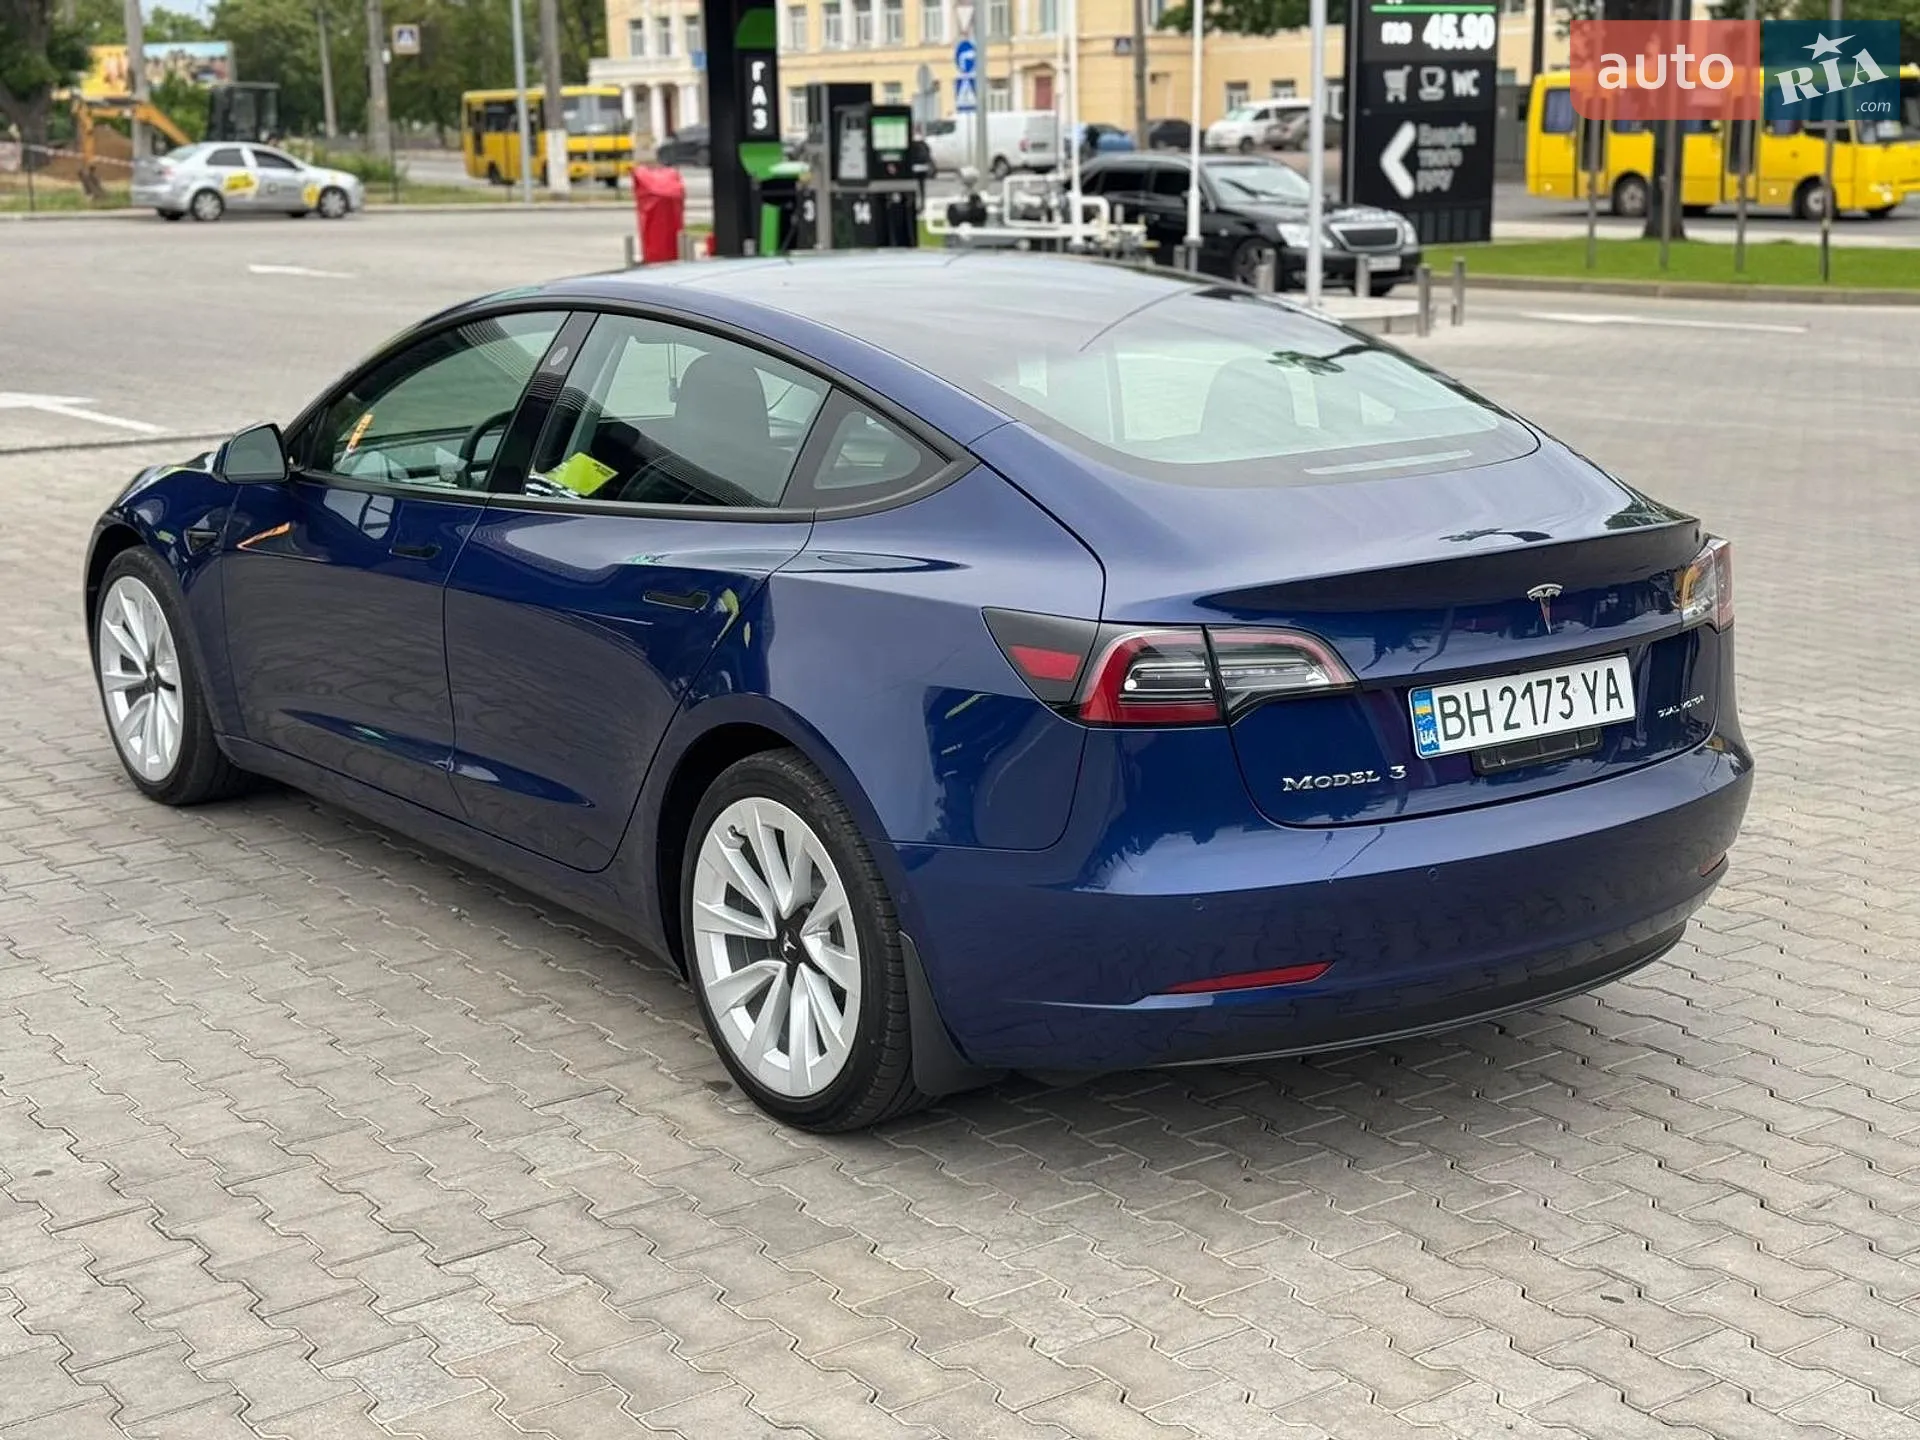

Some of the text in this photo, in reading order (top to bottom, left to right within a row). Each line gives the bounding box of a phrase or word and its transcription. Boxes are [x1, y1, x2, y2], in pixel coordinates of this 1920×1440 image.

[1422, 13, 1496, 50] 45.90
[751, 61, 768, 130] ГАЗ
[1451, 69, 1480, 97] WC
[1438, 667, 1624, 742] BH 2173 YA
[1419, 728, 1438, 746] UA
[1282, 765, 1407, 792] MODEL 3
